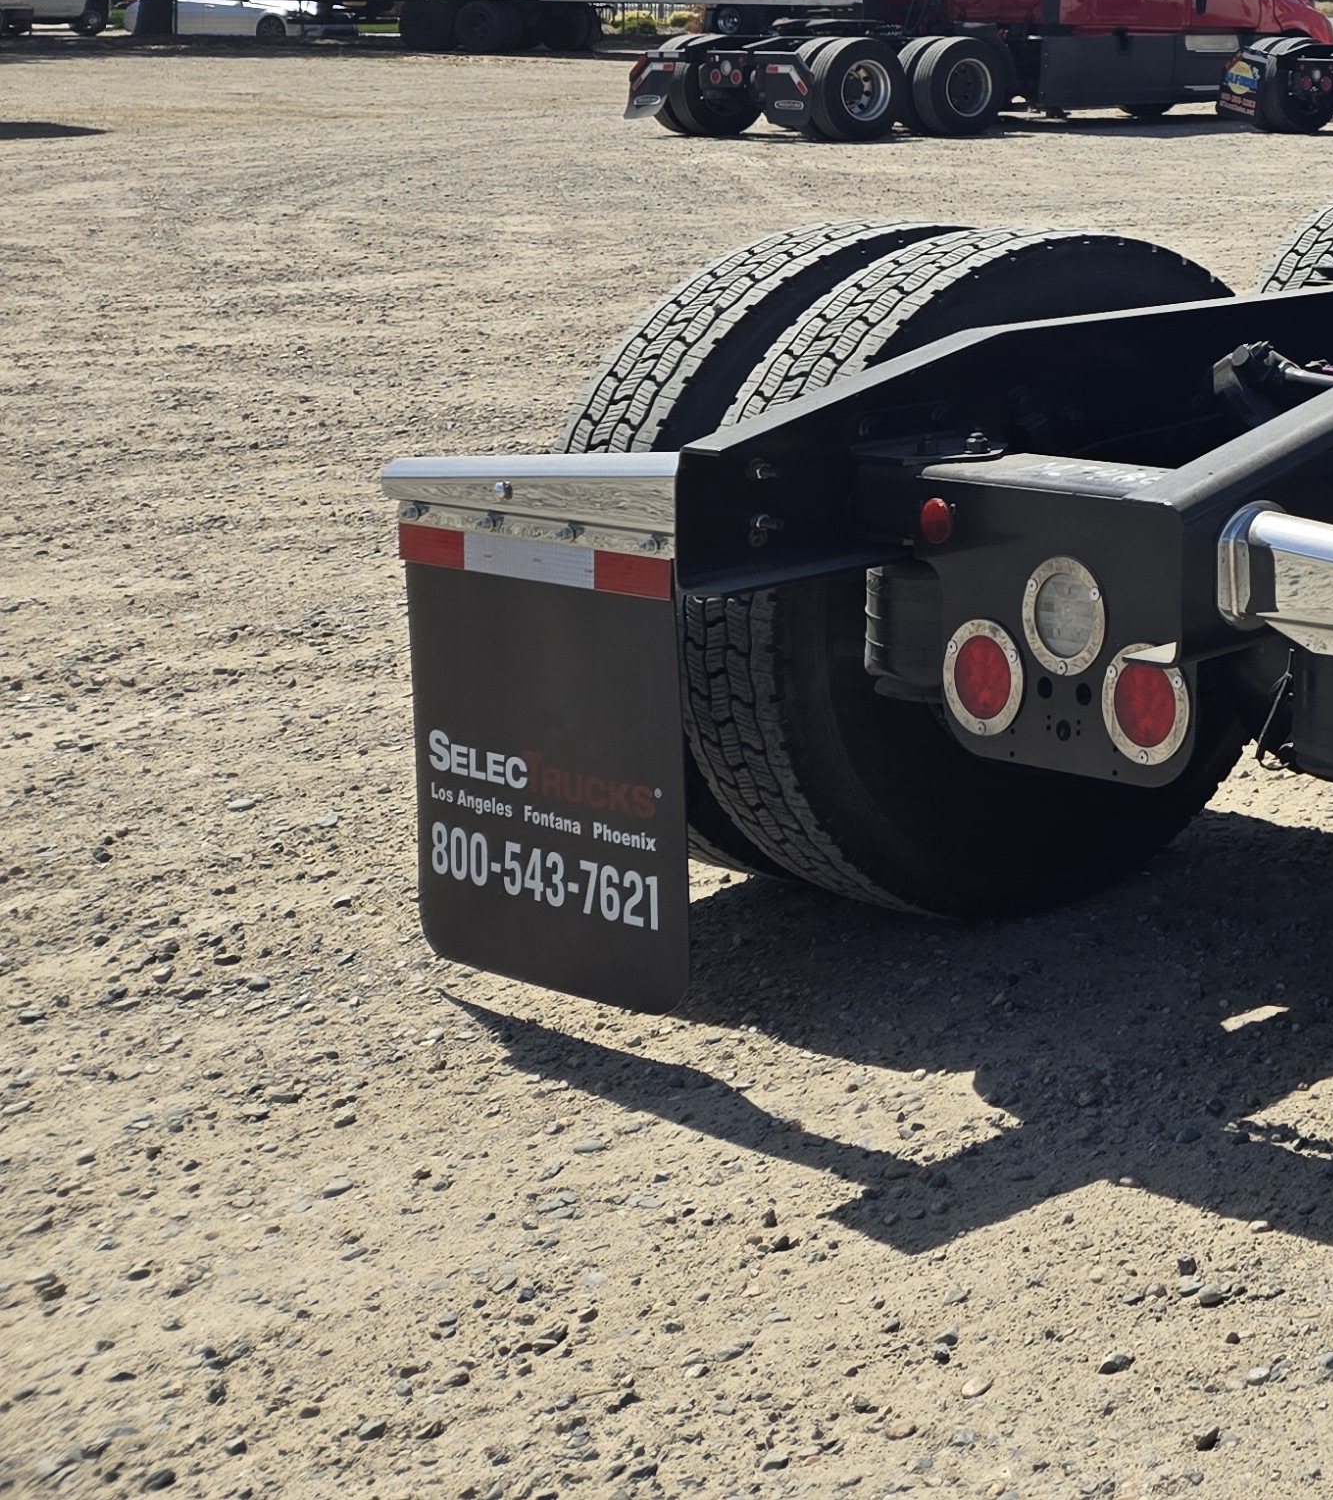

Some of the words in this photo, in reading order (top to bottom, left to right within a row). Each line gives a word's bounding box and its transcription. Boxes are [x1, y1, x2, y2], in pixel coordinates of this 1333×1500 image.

[430, 781, 454, 803] Los
[457, 789, 513, 818] Angeles
[524, 805, 582, 835] Fontana
[593, 821, 657, 851] Phoenix
[431, 821, 660, 931] 800-543-7621
